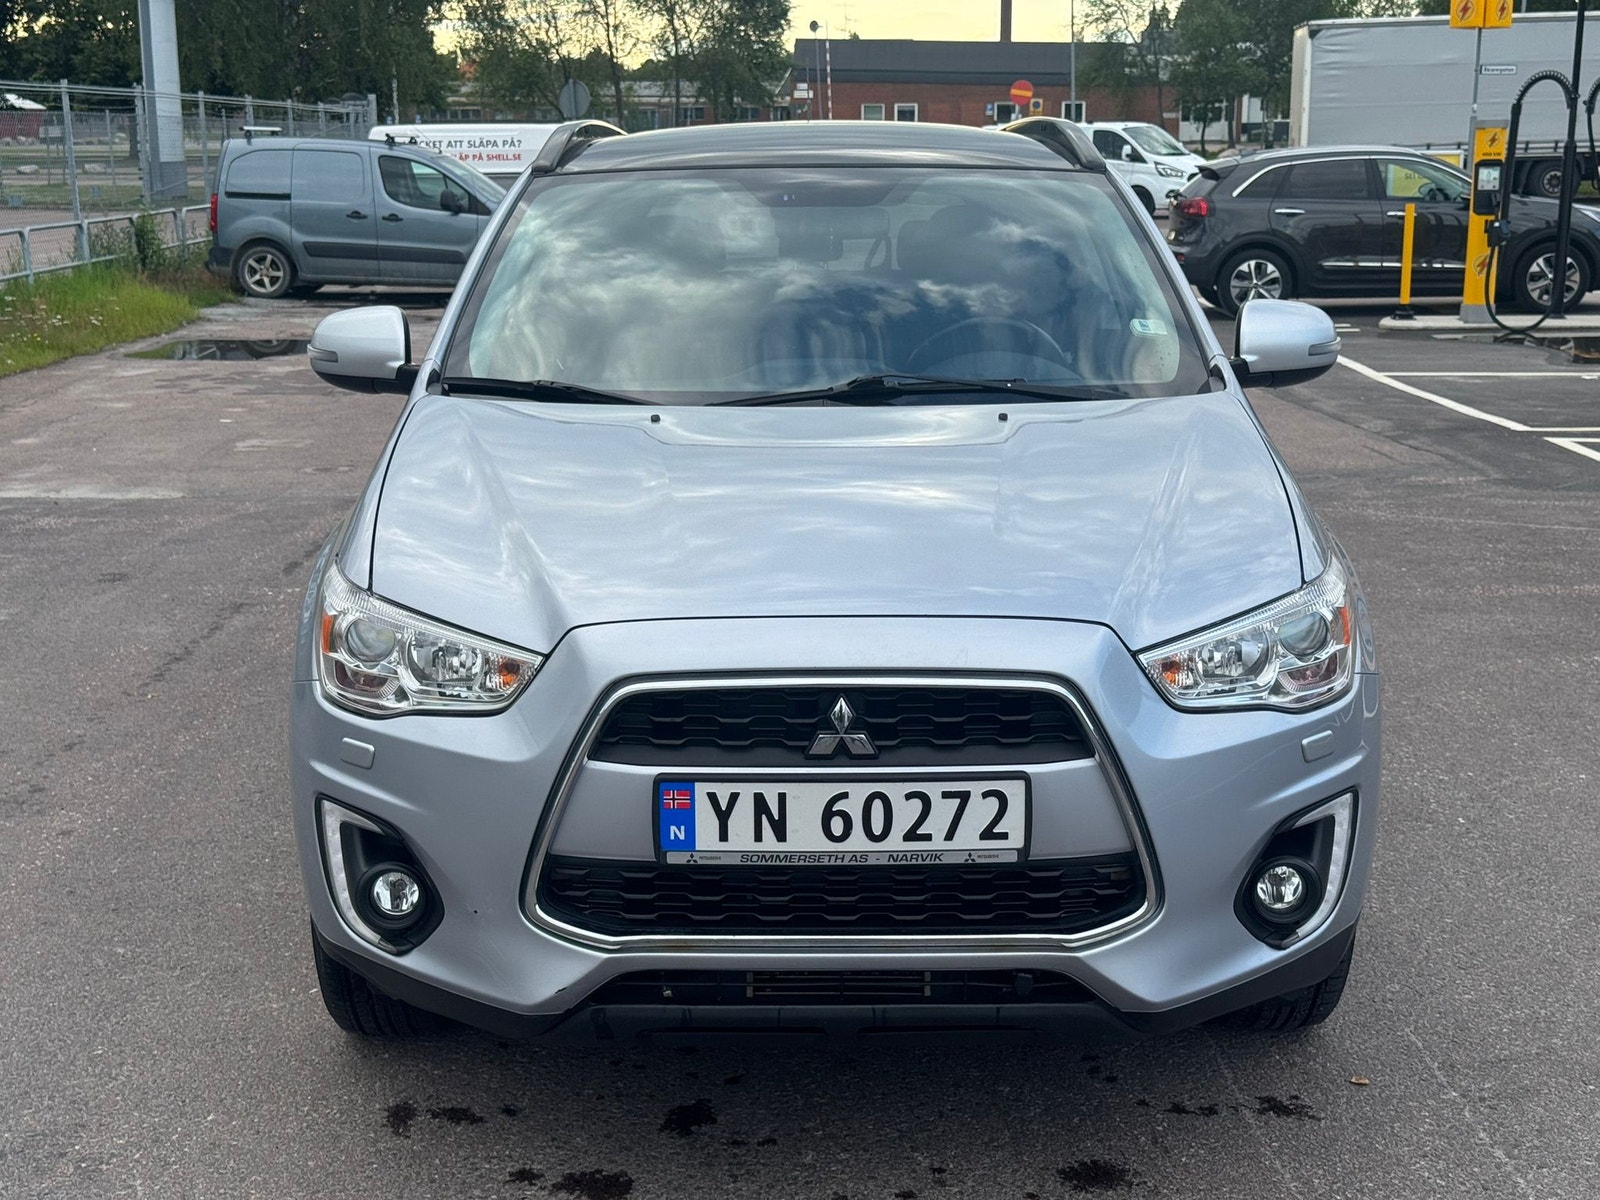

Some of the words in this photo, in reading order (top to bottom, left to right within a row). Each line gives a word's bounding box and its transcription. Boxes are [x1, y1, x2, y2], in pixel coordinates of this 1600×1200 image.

[446, 139, 464, 149] ATT
[467, 137, 499, 149] SLÄPA
[502, 137, 522, 149] PÅ?
[472, 152, 483, 162] PÅ
[486, 153, 522, 161] SHELL.SE
[706, 791, 787, 843] YN
[821, 789, 1009, 843] 60272
[670, 825, 685, 840] N
[740, 854, 844, 864] SOMMERSETH
[848, 854, 869, 863] AS
[887, 853, 944, 863] NARVIK
